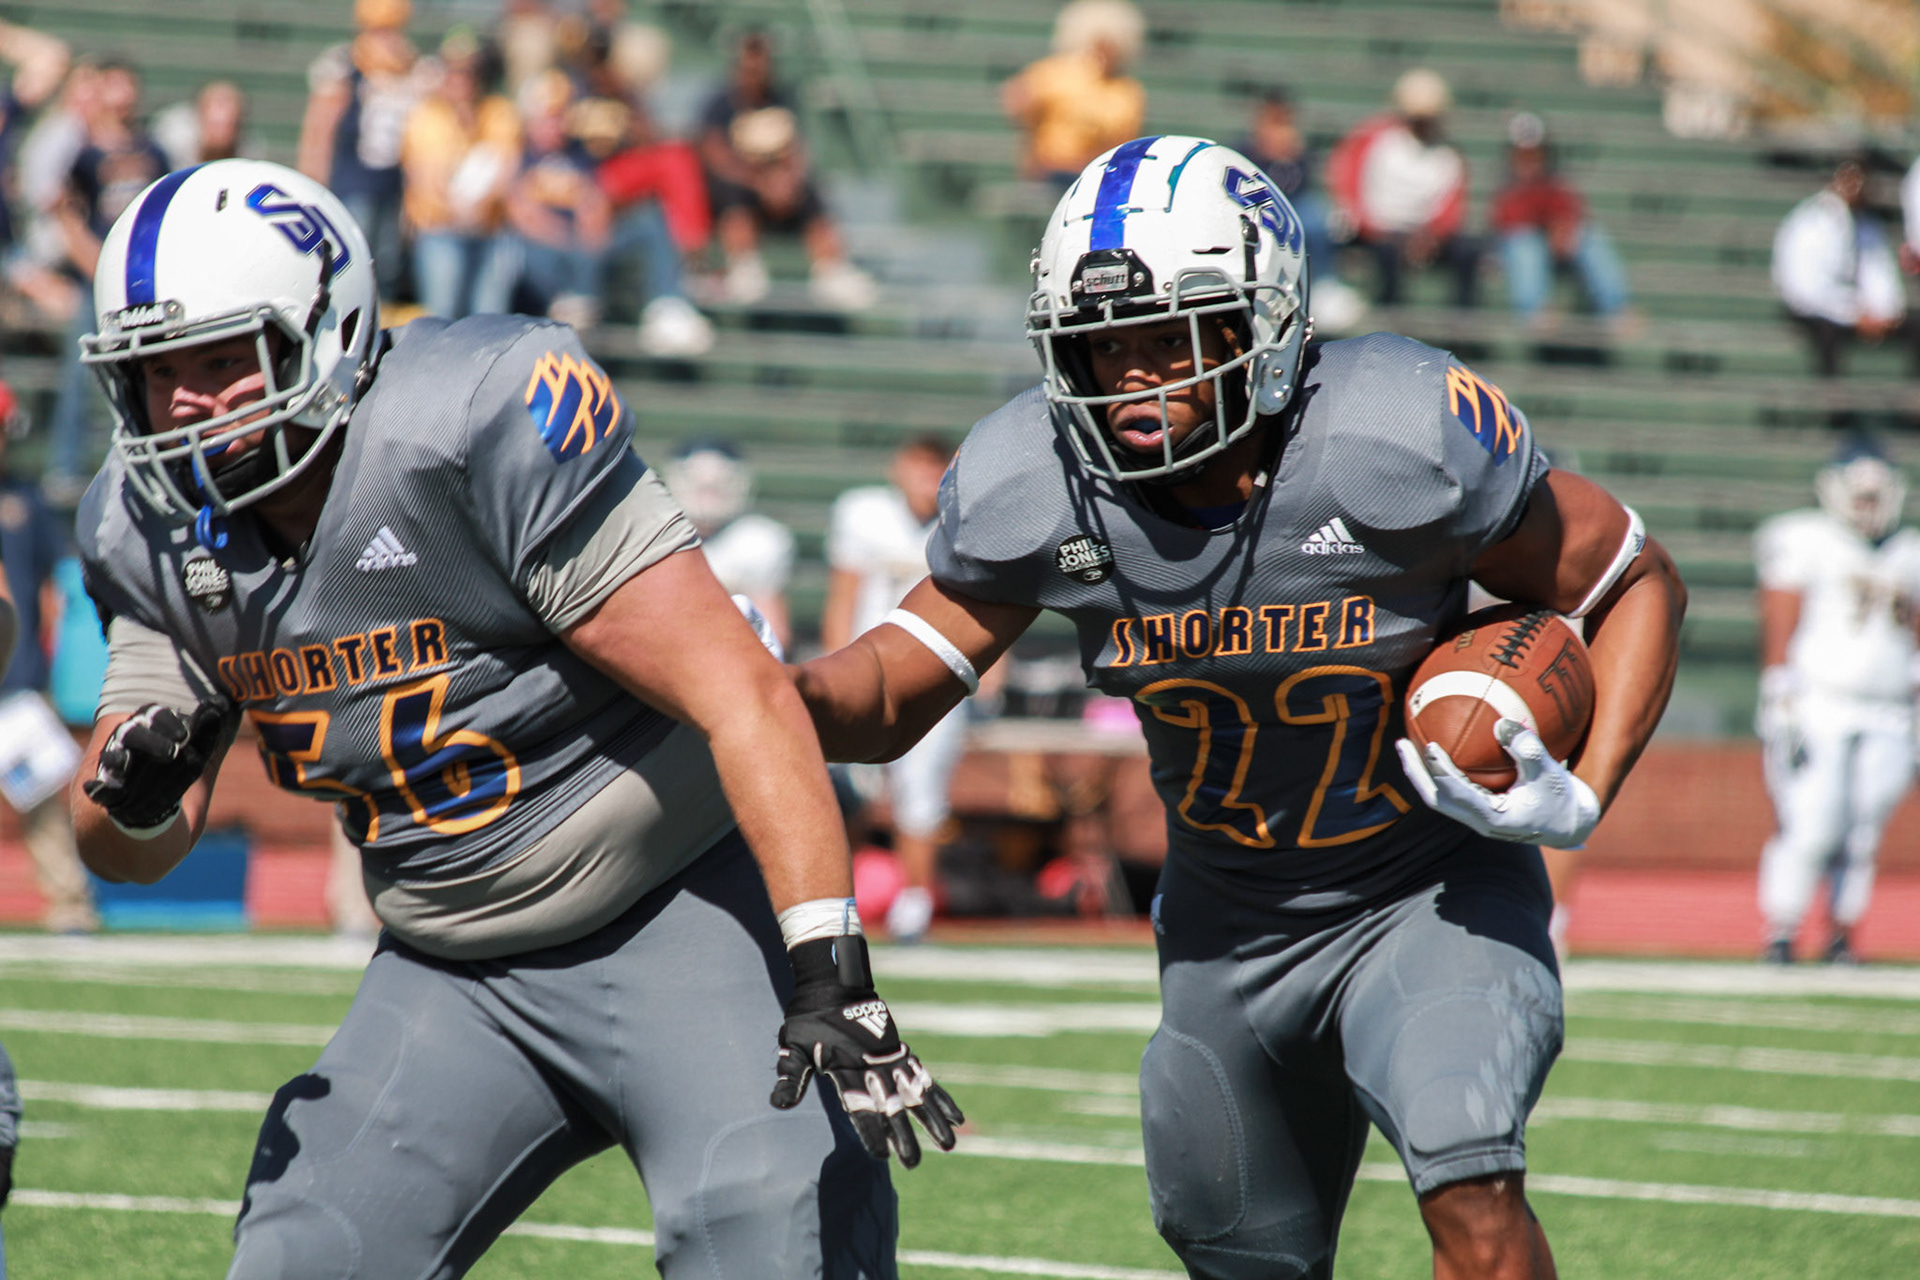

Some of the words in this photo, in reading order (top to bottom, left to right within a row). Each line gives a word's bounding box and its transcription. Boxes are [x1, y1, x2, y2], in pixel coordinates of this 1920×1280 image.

[1059, 545, 1110, 569] JONES
[1060, 538, 1098, 556] PHIL
[1301, 540, 1365, 555] adidas
[1109, 595, 1375, 667] SHORTER
[218, 617, 449, 701] SHORTER
[1134, 665, 1412, 848] 22
[843, 1001, 887, 1020] adidas
